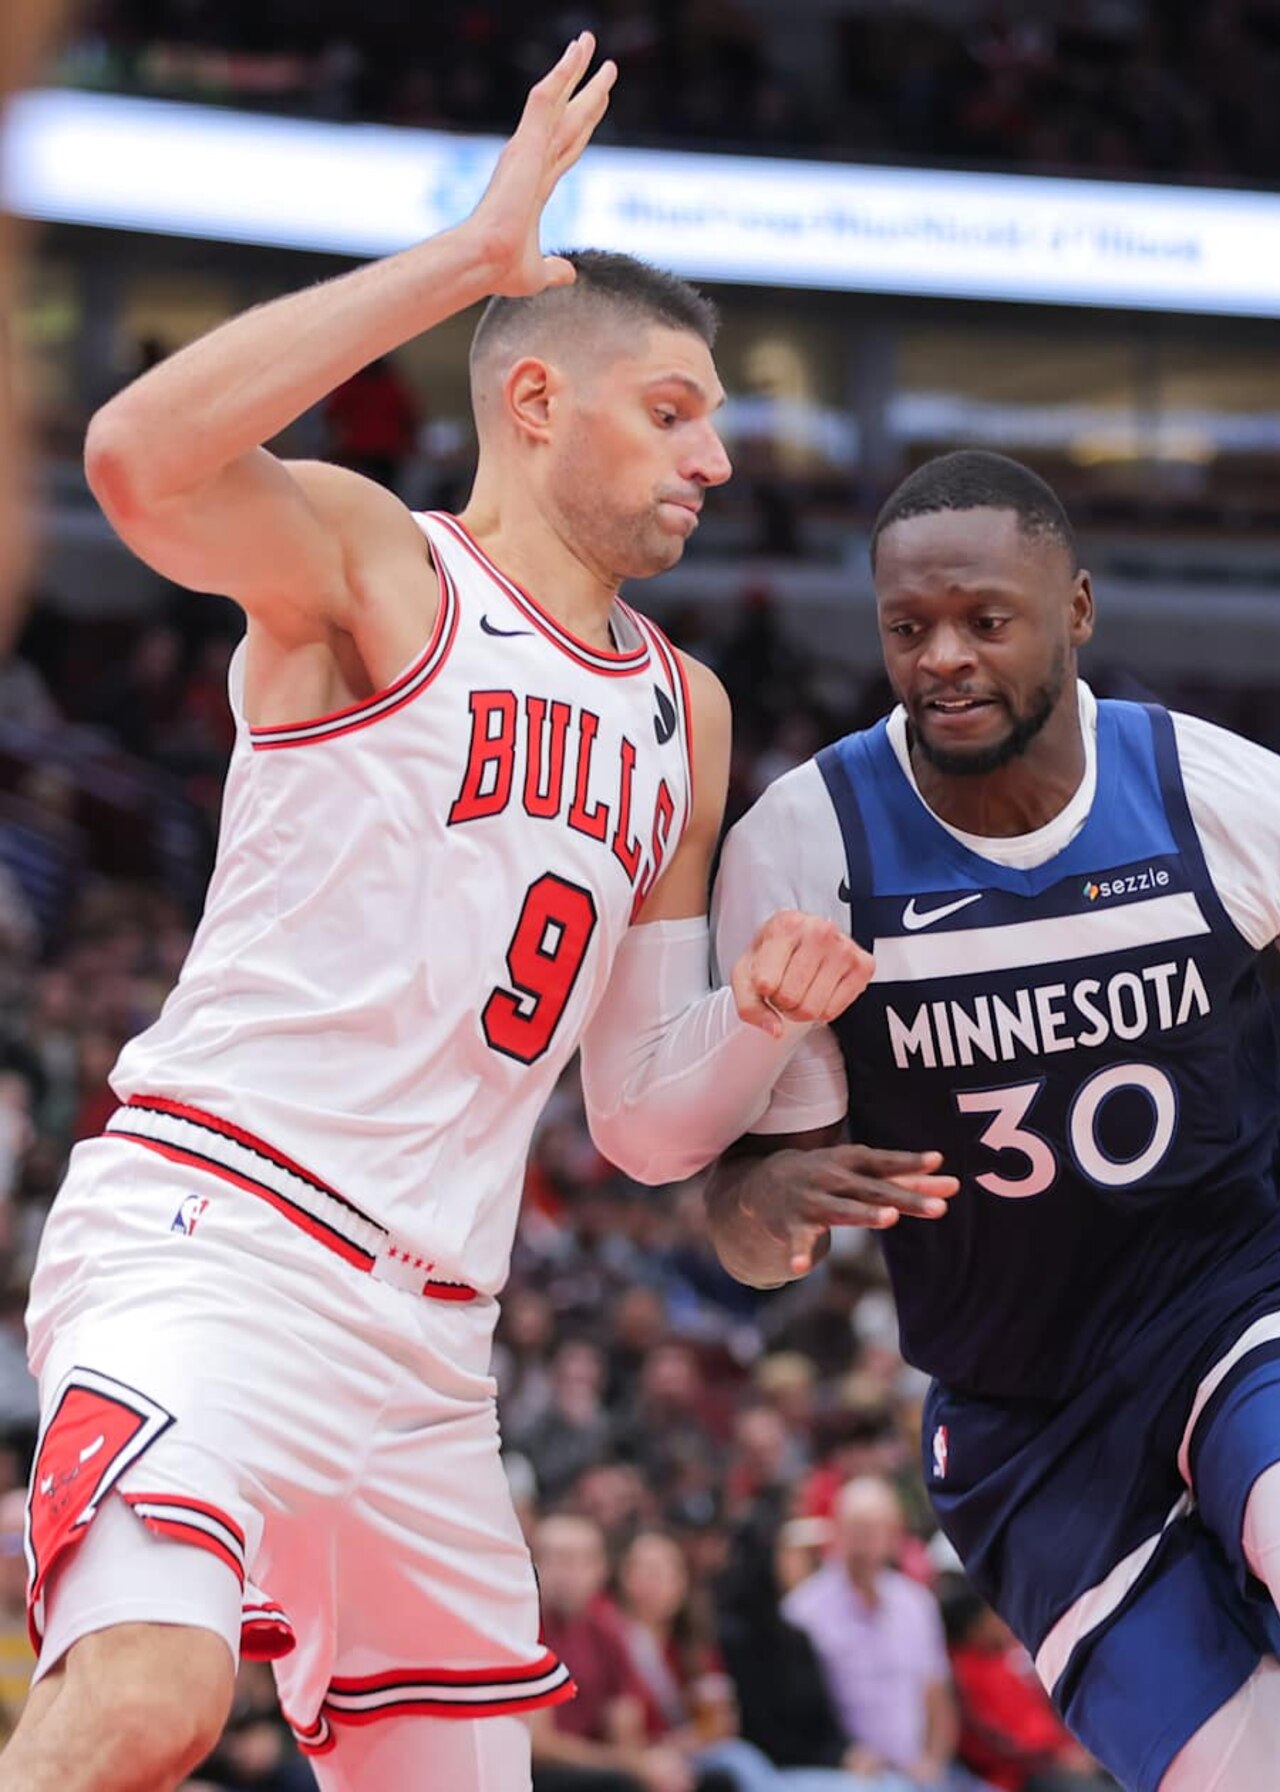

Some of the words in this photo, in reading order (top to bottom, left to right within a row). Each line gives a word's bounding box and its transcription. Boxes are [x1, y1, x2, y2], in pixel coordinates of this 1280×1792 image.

[446, 689, 675, 925] BULLS
[1099, 867, 1170, 897] sezzle
[480, 870, 599, 1067] 9
[885, 957, 1212, 1070] MINNESOTA
[953, 1061, 1179, 1200] 30
